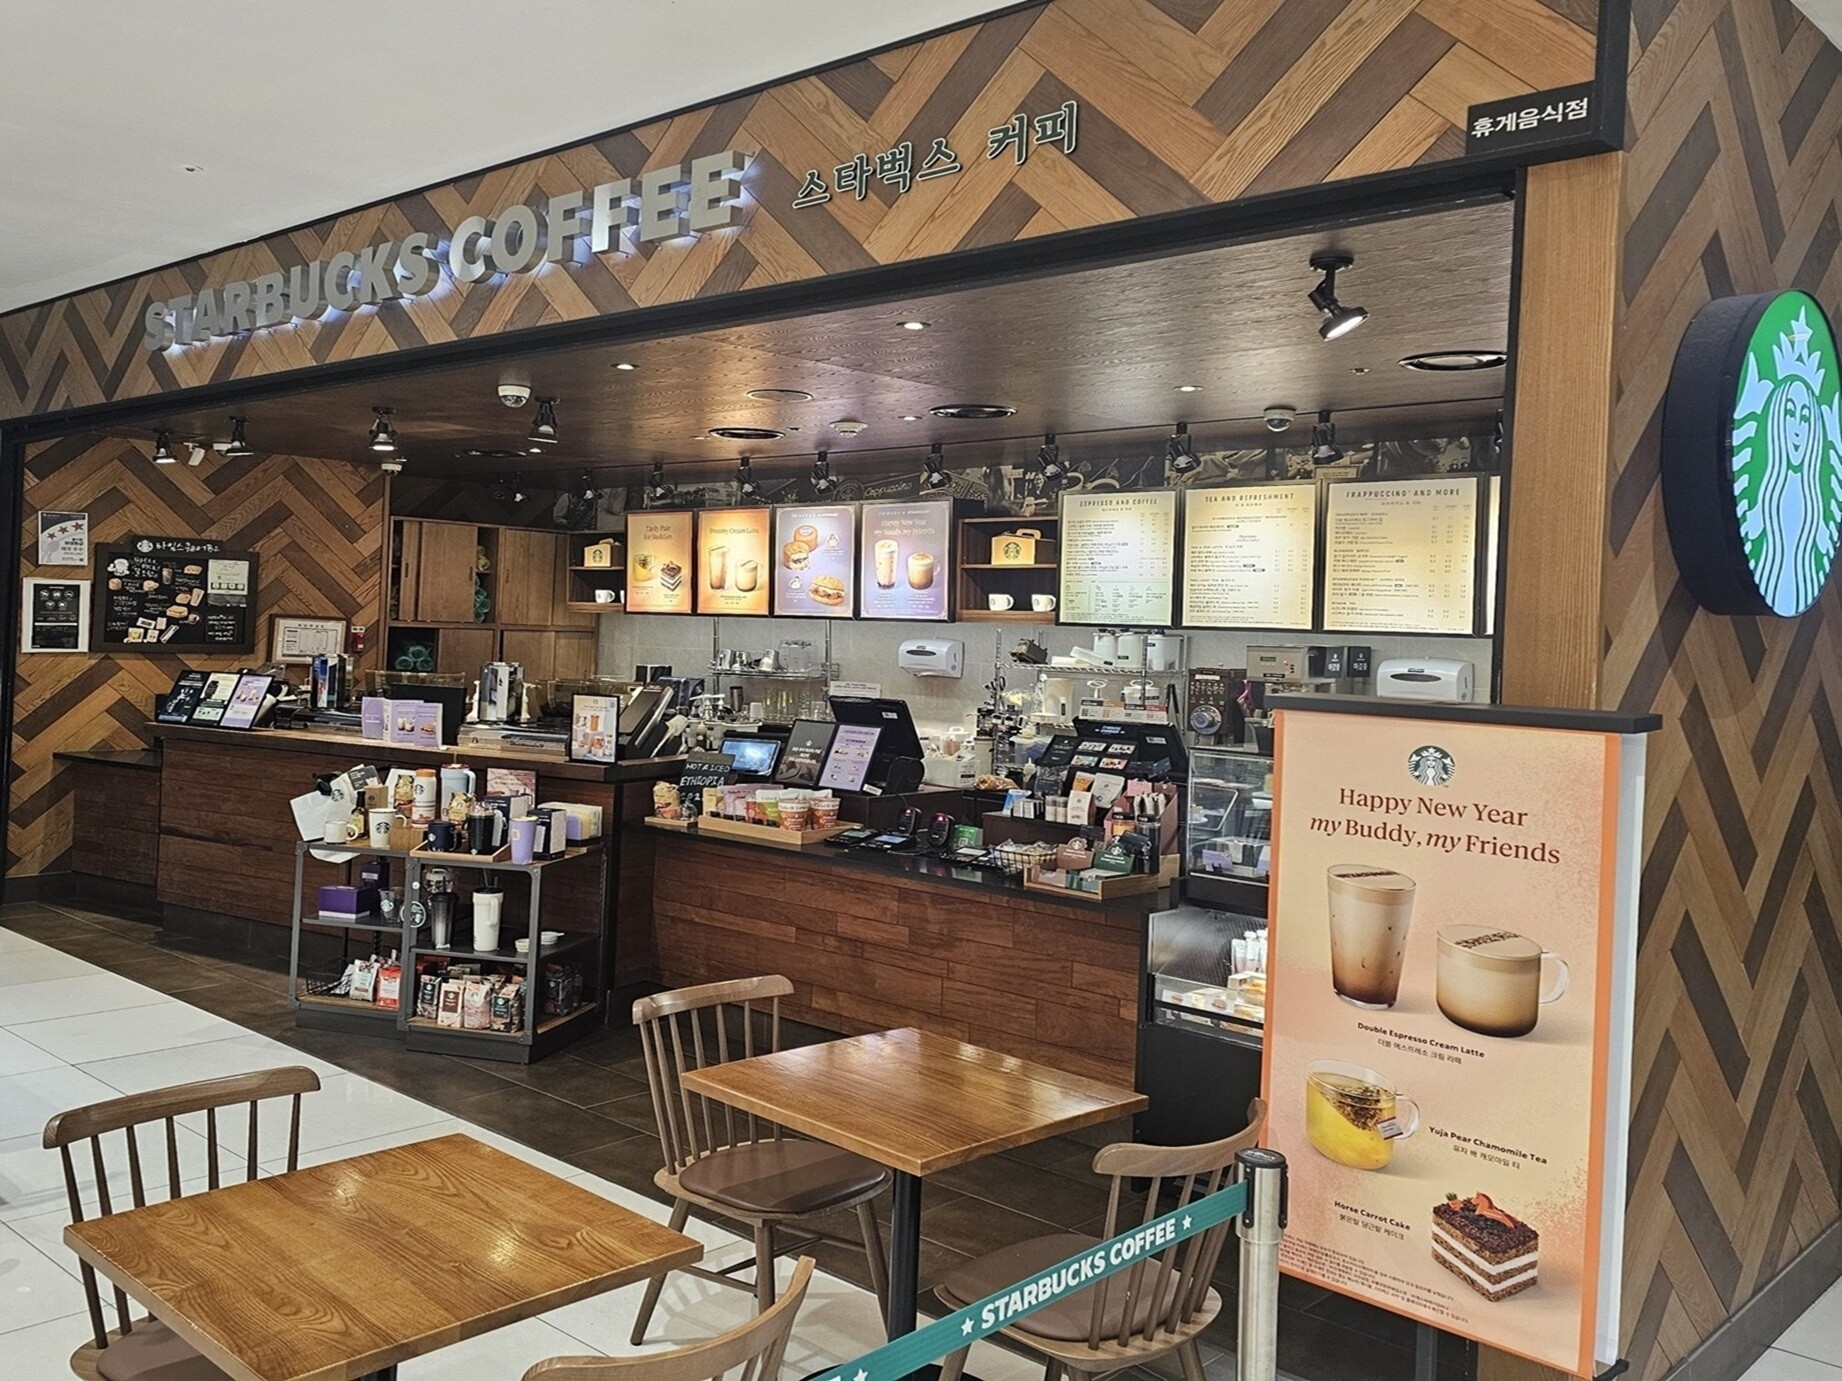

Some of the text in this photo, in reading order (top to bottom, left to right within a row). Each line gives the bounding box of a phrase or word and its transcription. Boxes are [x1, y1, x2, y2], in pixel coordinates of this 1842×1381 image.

[1471, 97, 1588, 138] 휴게음식점
[792, 100, 1078, 209] 스타벅스 커피
[144, 149, 748, 352] STARBUCKS COFFEE
[1079, 499, 1113, 507] ESPRESSO
[1132, 498, 1158, 506] COFFEE
[1239, 492, 1295, 501] REFRESHMENT
[1413, 489, 1432, 497] AND
[1435, 488, 1460, 496] MORE
[679, 775, 725, 787] ETHIOPIA
[685, 763, 703, 771] HOT
[1339, 787, 1529, 827] Happy New Year
[1310, 817, 1561, 864] my Buddy, my Friends
[1357, 1022, 1485, 1058] Double Espresso Cream Latte
[1393, 1042, 1429, 1056] 에스프레소
[1430, 1051, 1445, 1061] 크림
[1429, 1126, 1548, 1165] Yuja Pear Chamomile Tea
[1452, 1144, 1468, 1156] 유자
[1479, 1151, 1510, 1168] 캐모마일
[1511, 1160, 1521, 1170] 티
[1334, 1200, 1411, 1231] Horse Carrot Cake
[1383, 1227, 1405, 1240] 케이크
[981, 1217, 1176, 1330] STARBUCKS COFFEE
